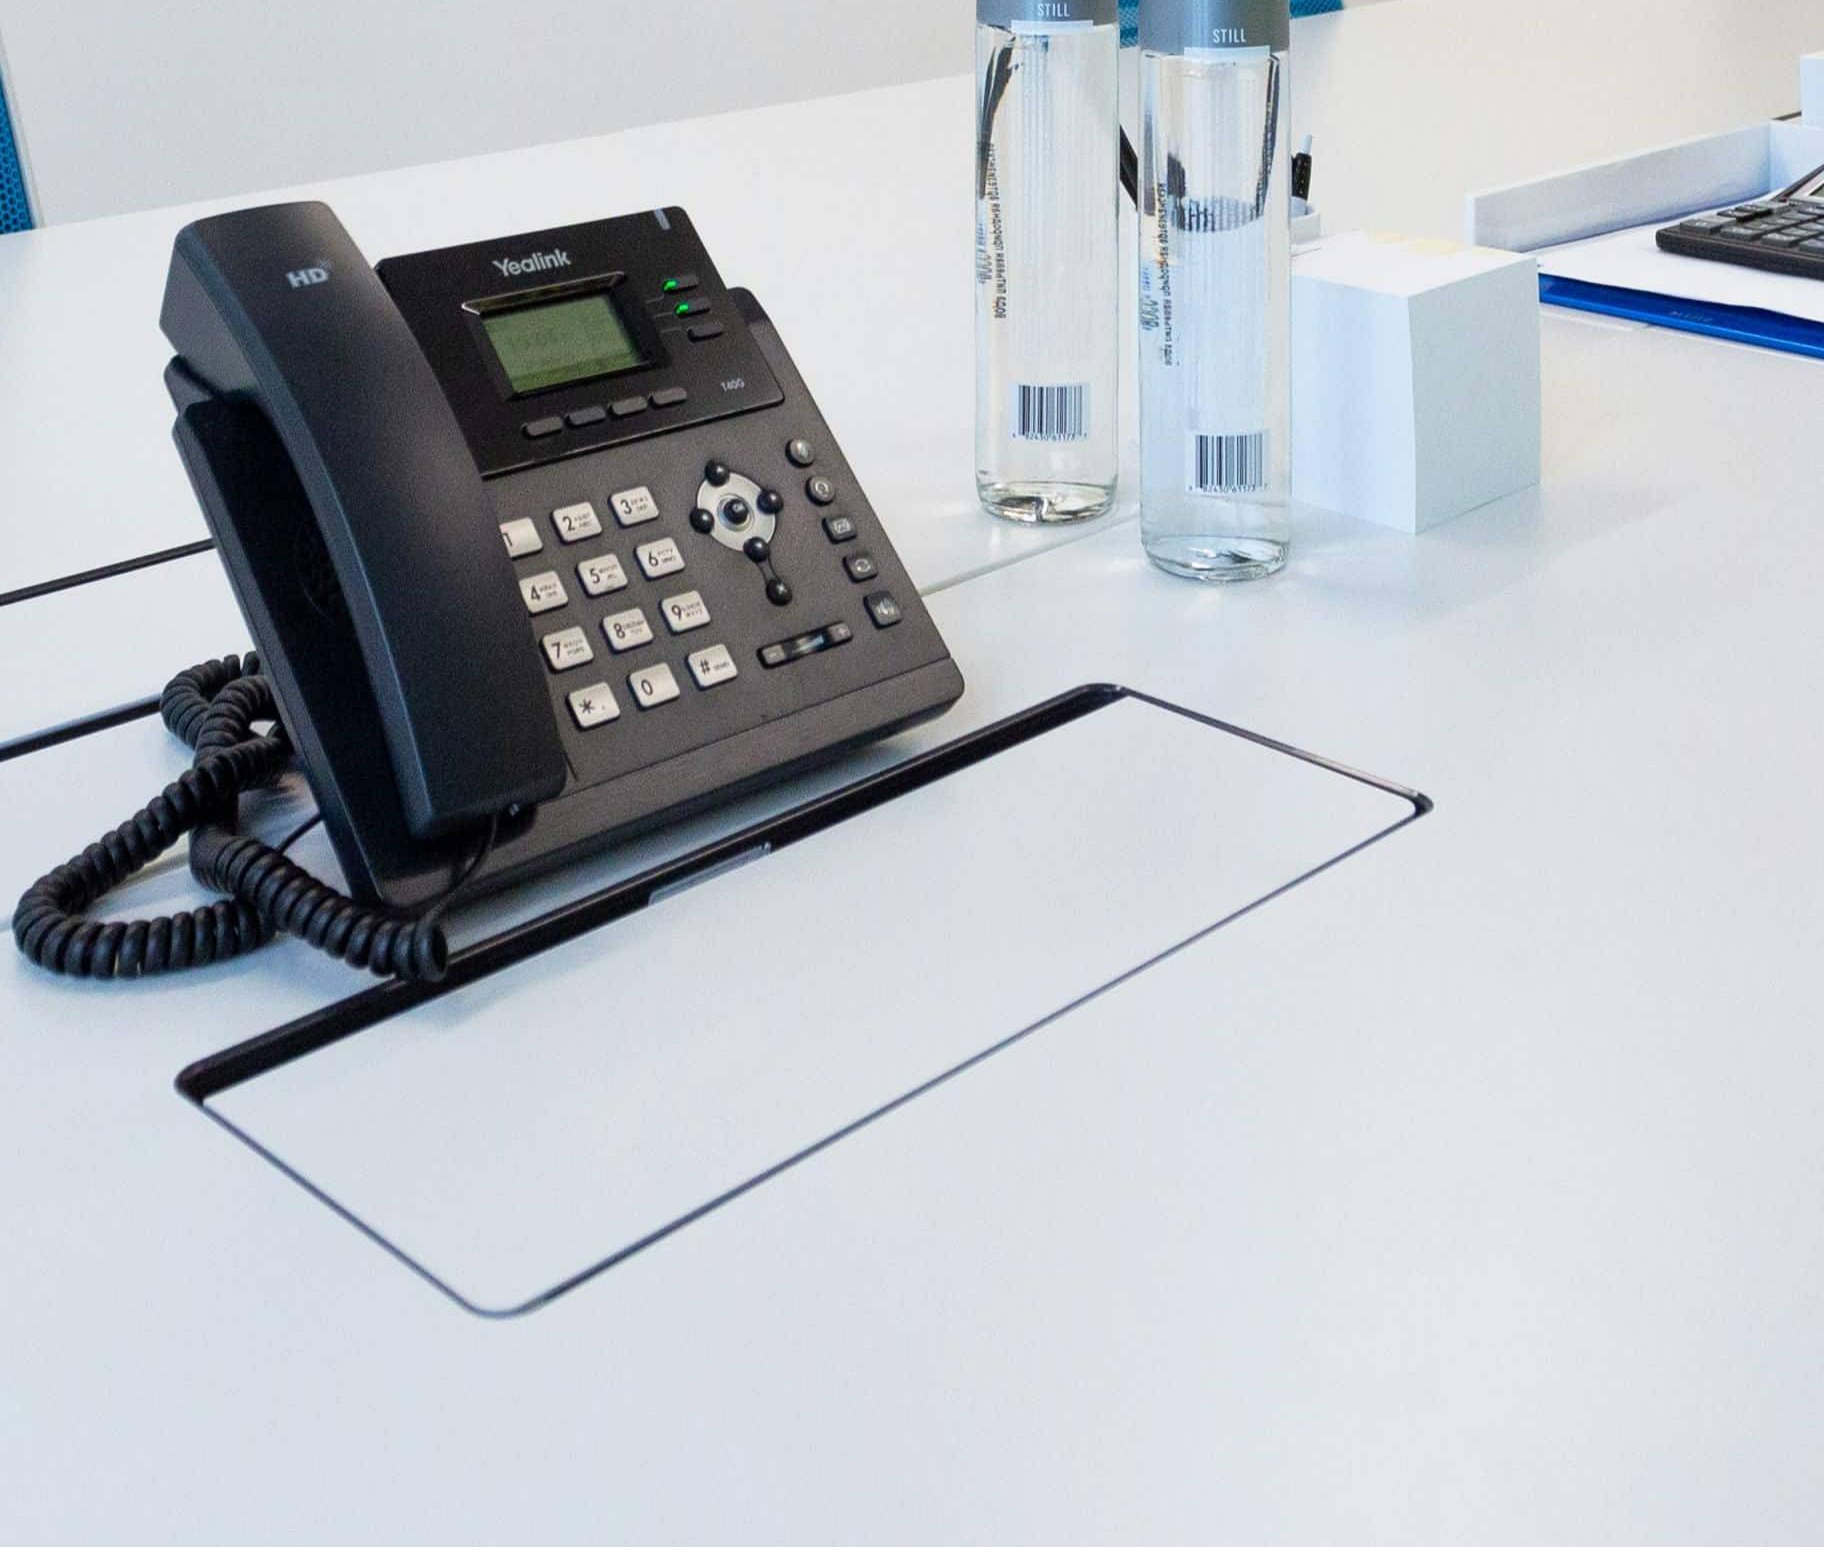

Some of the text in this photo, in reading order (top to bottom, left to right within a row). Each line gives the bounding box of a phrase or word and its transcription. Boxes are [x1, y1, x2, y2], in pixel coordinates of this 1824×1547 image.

[1037, 3, 1071, 17] STILL
[1212, 28, 1247, 44] STILL
[492, 248, 573, 278] Yealink
[285, 266, 330, 289] HD
[620, 499, 633, 515] 3
[562, 515, 576, 532] 2
[648, 551, 659, 567] 6
[590, 568, 601, 584] 5
[530, 585, 541, 602] 4
[671, 604, 682, 621] 9
[613, 622, 625, 639] 8
[551, 642, 561, 660] 7
[640, 679, 654, 696] 0
